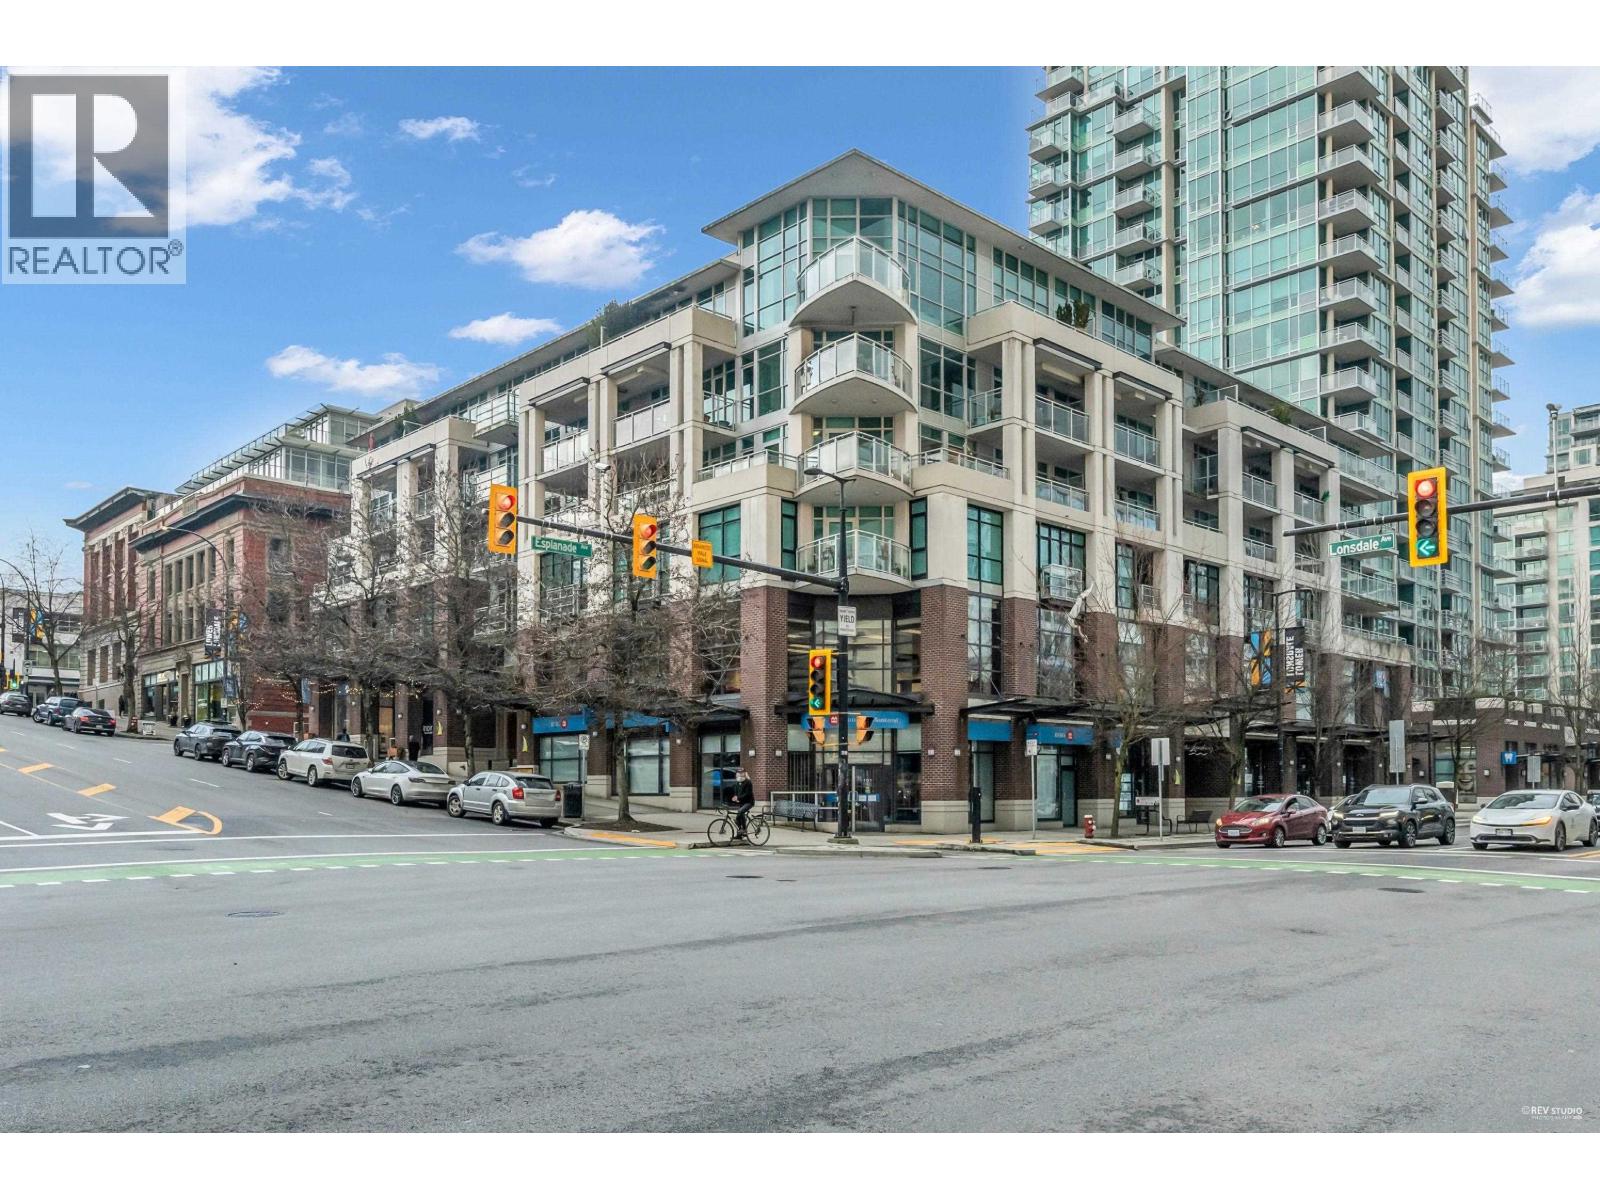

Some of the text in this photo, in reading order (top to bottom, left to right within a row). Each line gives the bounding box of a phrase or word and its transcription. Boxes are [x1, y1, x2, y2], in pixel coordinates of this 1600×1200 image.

[535, 537, 577, 553] Esplanade
[1330, 539, 1379, 556] Lonsdale
[840, 615, 854, 623] YIELD
